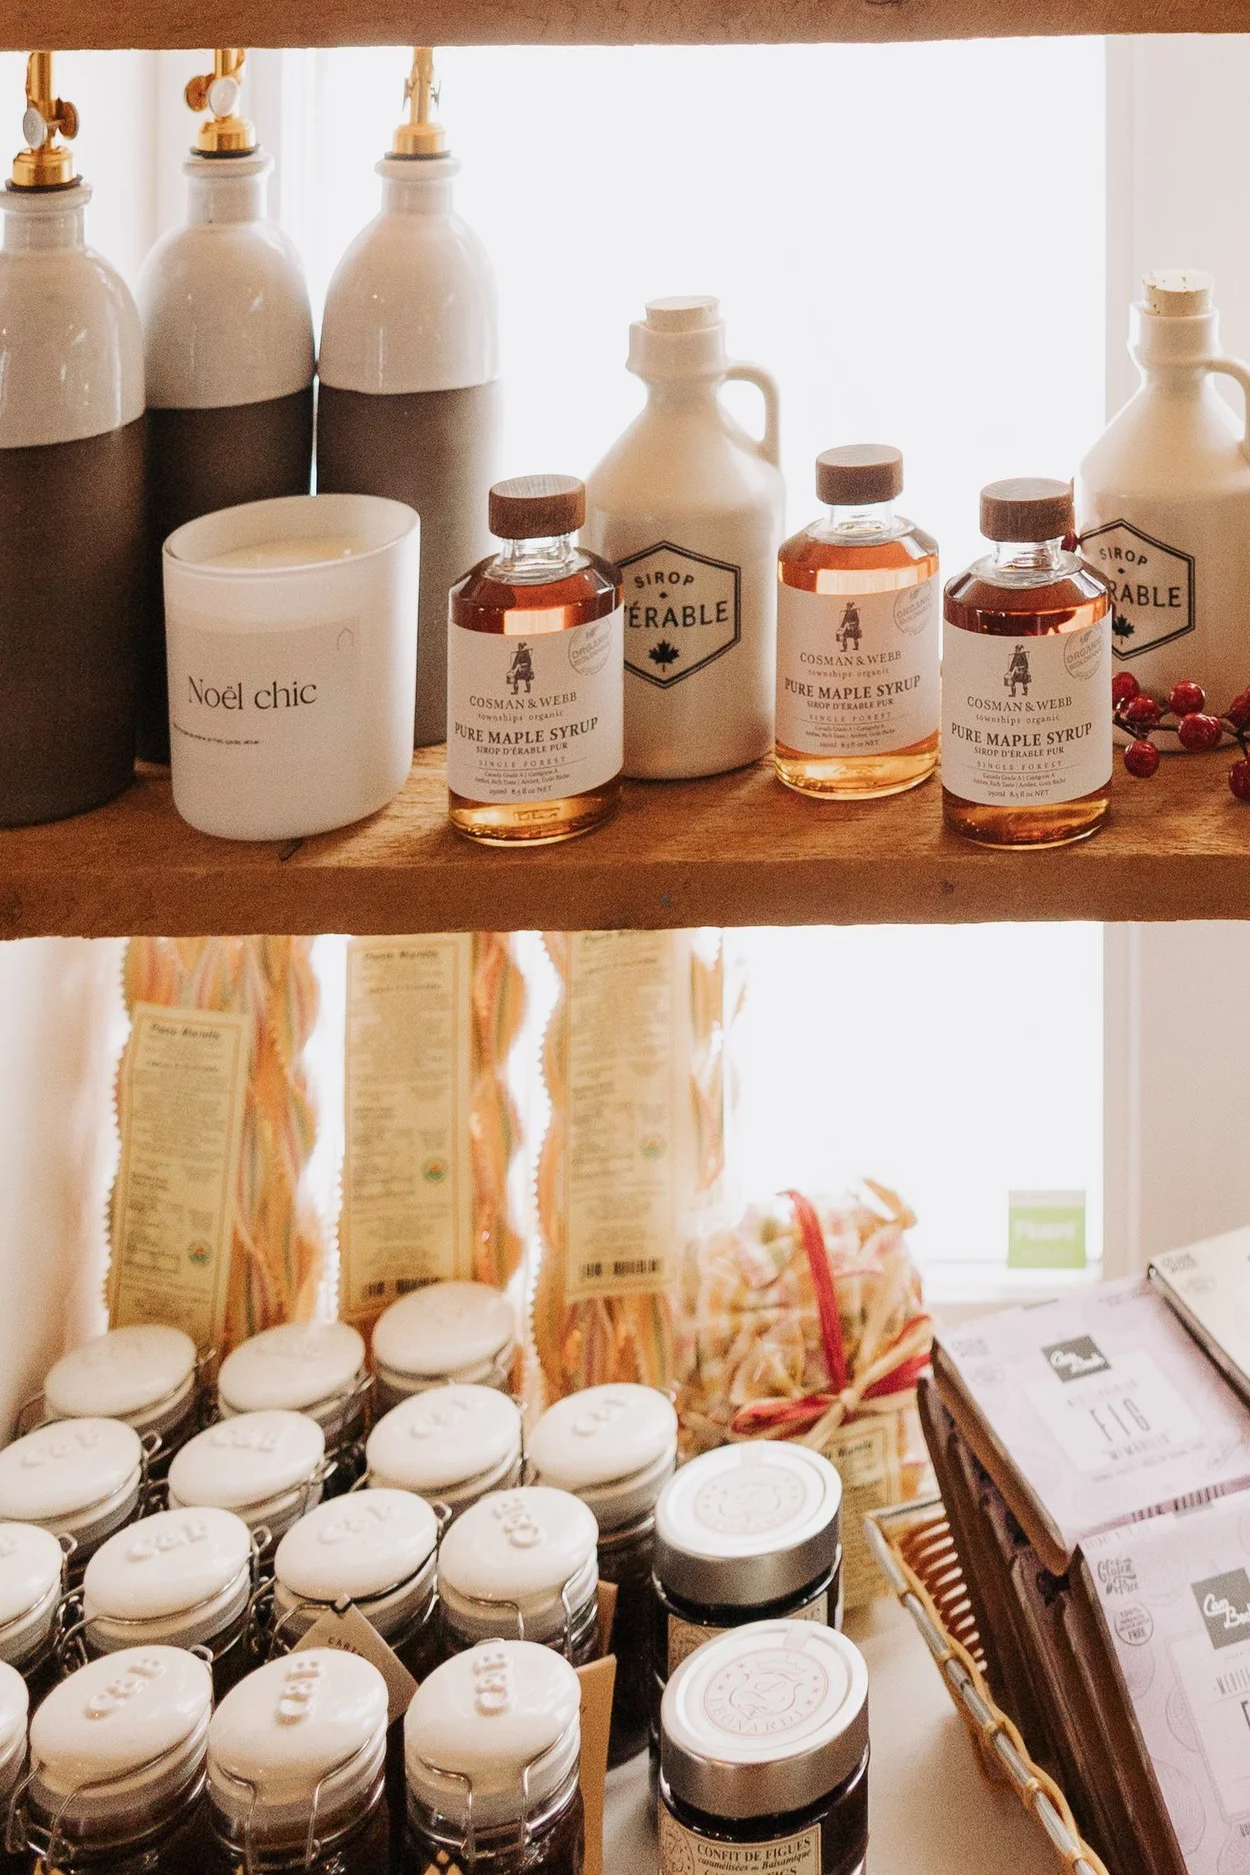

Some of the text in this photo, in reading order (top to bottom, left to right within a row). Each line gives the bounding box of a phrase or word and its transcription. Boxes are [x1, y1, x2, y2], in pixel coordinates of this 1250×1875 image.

[1100, 547, 1148, 566] SIROP
[634, 571, 695, 589] SIROP
[624, 600, 728, 628] 'ÉRABLE
[800, 651, 865, 667] COSMAN &
[857, 667, 889, 678] organic
[188, 676, 317, 710] Noël chic
[785, 675, 921, 700] PURE MAPLE SYRUP
[469, 691, 577, 710] COSMAN & WEBB
[807, 698, 894, 710] SIROP PUR
[967, 695, 1072, 712] COSMAN & WEBB
[478, 709, 564, 724] townships organic
[976, 713, 1060, 726] townships organic
[455, 717, 598, 745] PURE MAPLE SYRUP
[951, 722, 1092, 747] PURE MAPLE SYRUP
[476, 741, 568, 756] SIROP D'ÉRABLE PUR
[974, 746, 1064, 758] SIROP D'ÉRABLE PUR
[479, 756, 566, 769] SINGLE FOREST
[697, 1836, 811, 1863] CONFIT DE FIGUES
[762, 1848, 812, 1870] Balsamique
